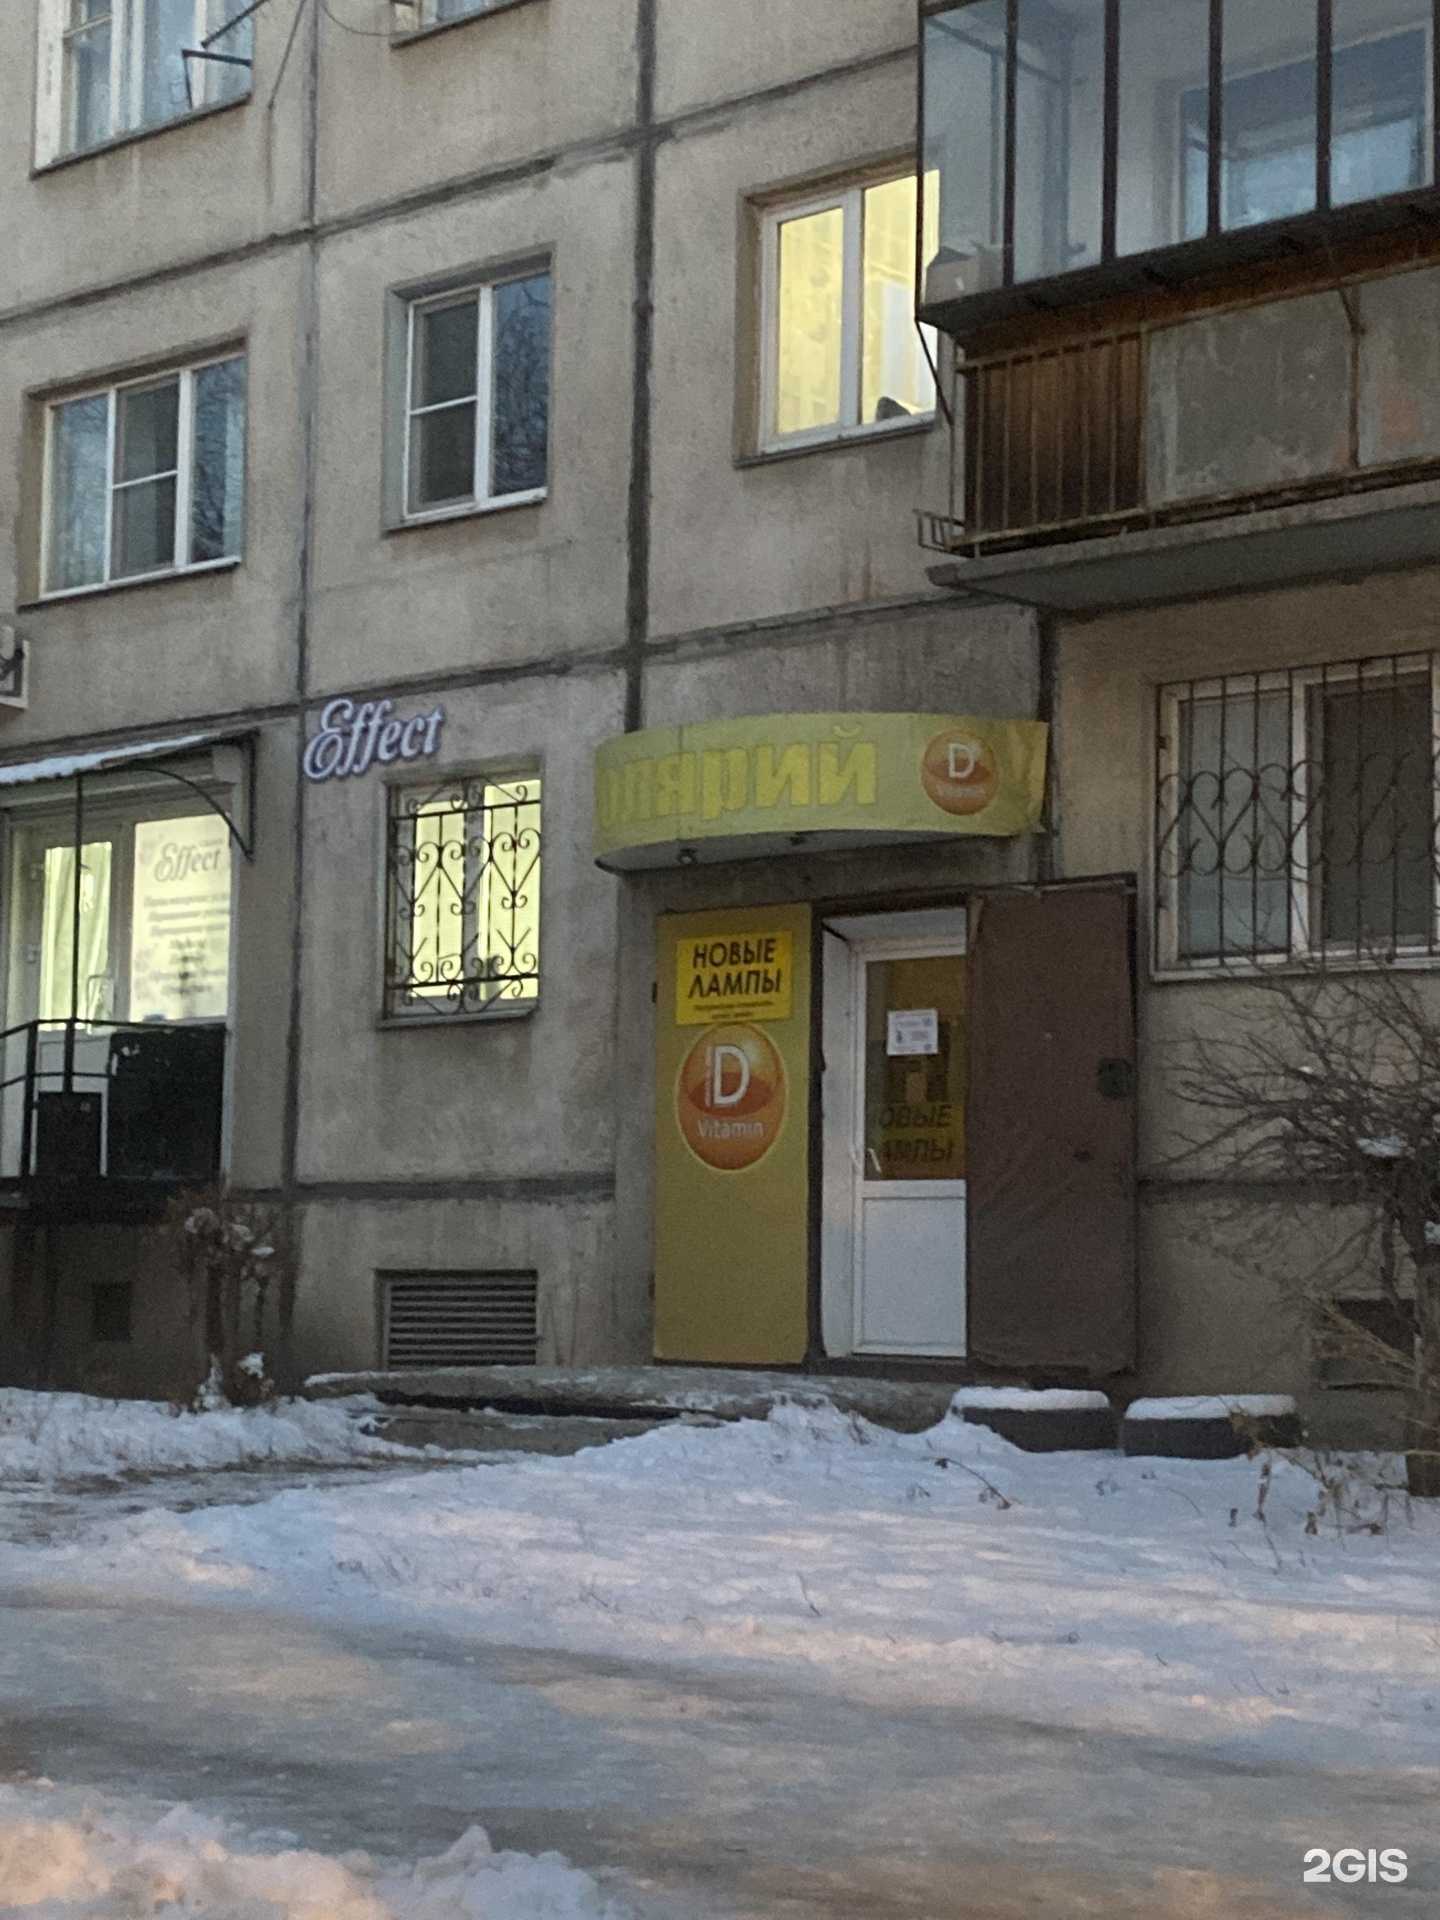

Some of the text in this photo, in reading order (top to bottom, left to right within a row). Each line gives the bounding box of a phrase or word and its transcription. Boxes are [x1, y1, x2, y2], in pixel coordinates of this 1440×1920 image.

[304, 698, 444, 782] Effect
[948, 742, 976, 779] D
[154, 842, 221, 883] Effect
[692, 938, 776, 969] НОВЫЕ
[687, 967, 782, 999] ЛАМПЫ
[712, 1044, 751, 1106] D
[697, 1118, 765, 1138] Vitamin
